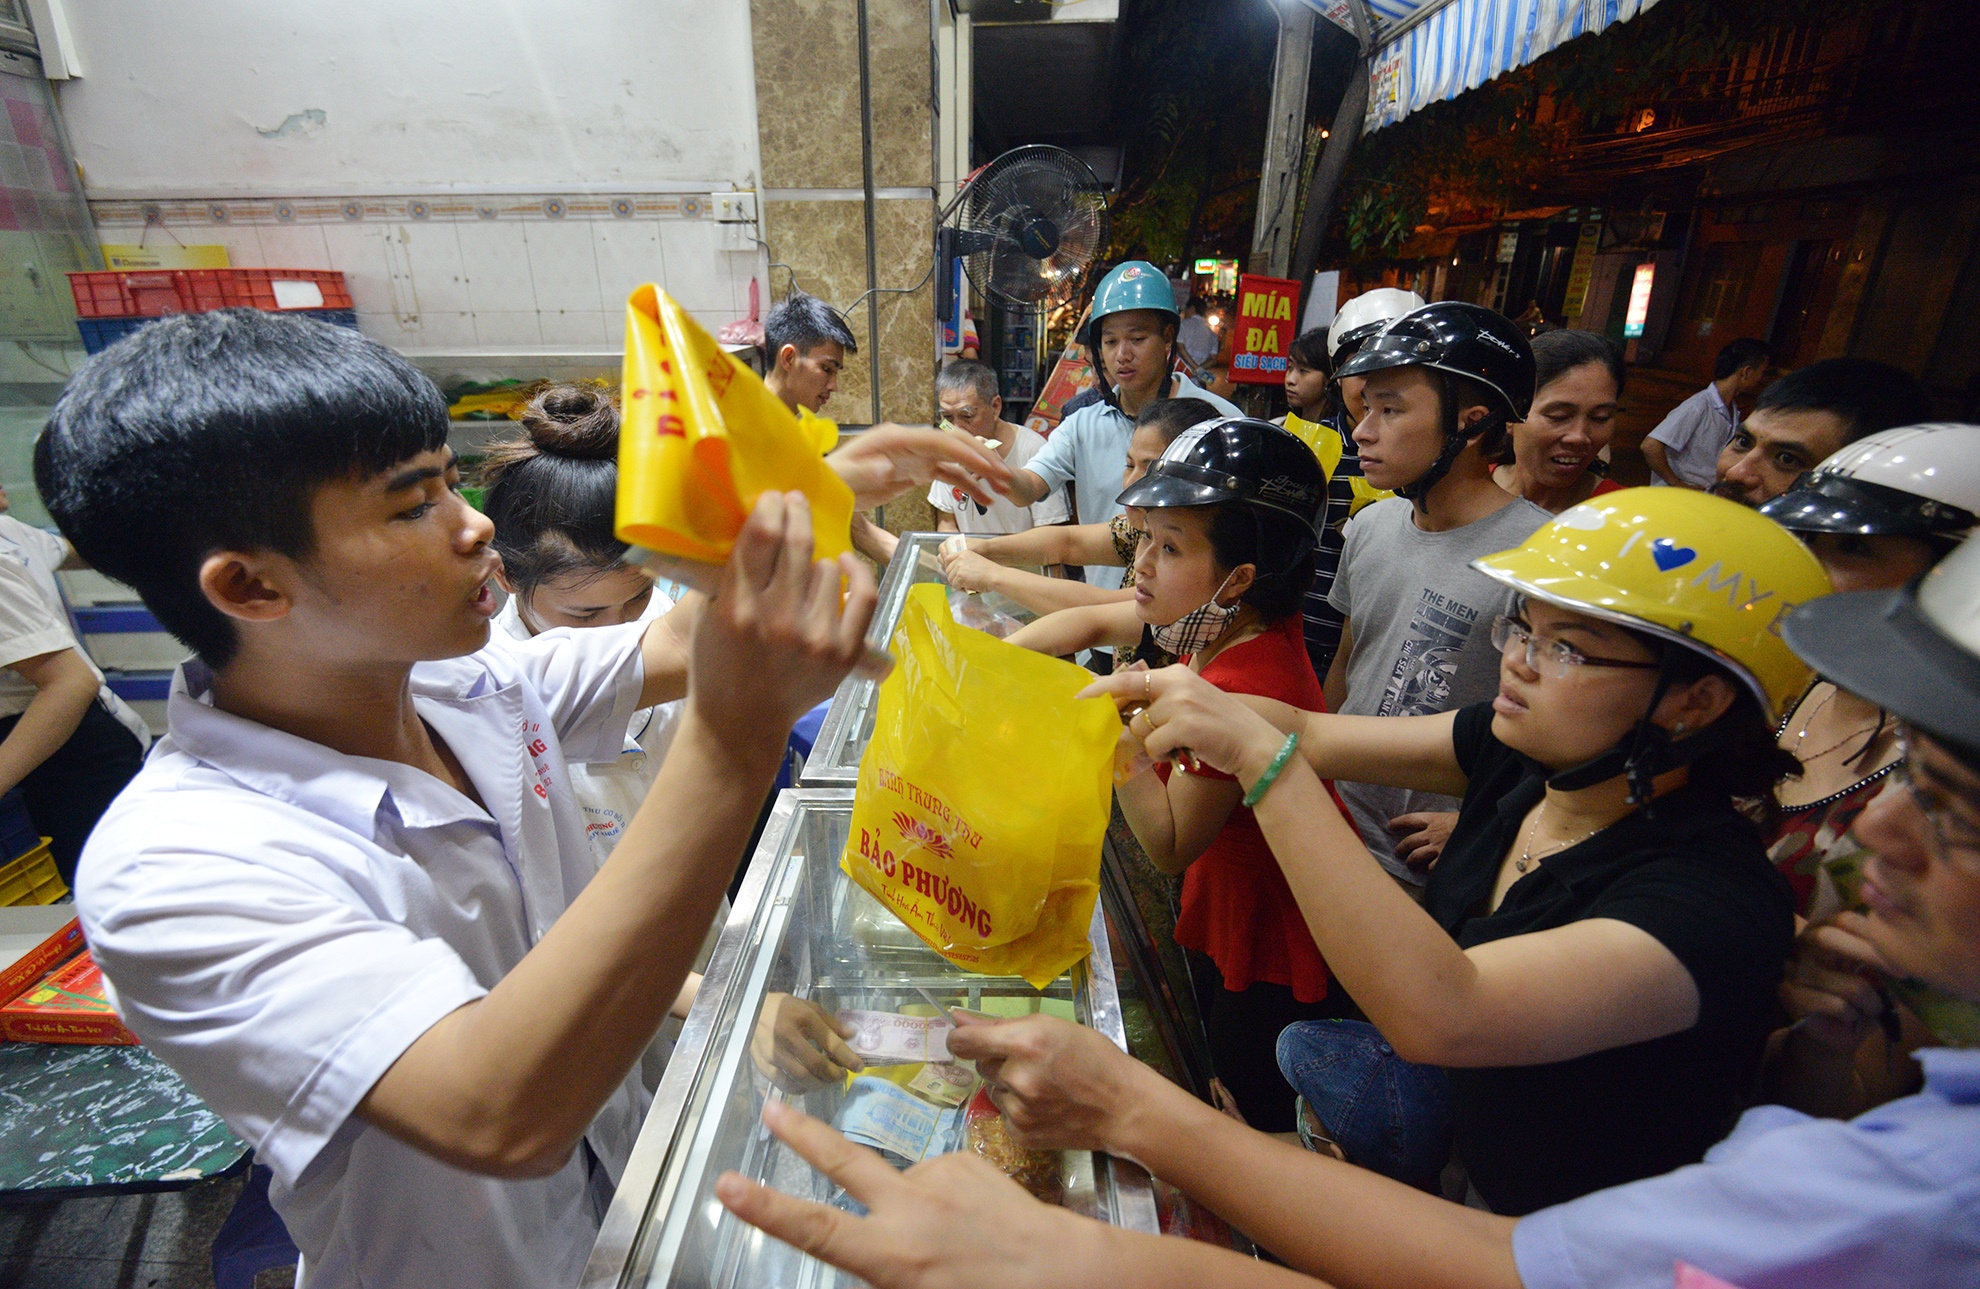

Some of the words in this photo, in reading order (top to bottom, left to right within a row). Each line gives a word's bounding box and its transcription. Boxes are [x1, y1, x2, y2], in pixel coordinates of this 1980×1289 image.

[1242, 290, 1291, 321] MÍA
[1246, 325, 1279, 353] ĐÁ
[1234, 352, 1258, 369] SIÊU
[1260, 355, 1287, 372] SẠCH
[1690, 560, 1775, 612] MY
[1422, 588, 1445, 607] THE
[1445, 600, 1479, 622] MEN
[906, 782, 951, 823] TRUNG
[955, 815, 983, 849] THU
[859, 828, 896, 878] BẢO
[901, 860, 993, 939] PHƯƠNG
